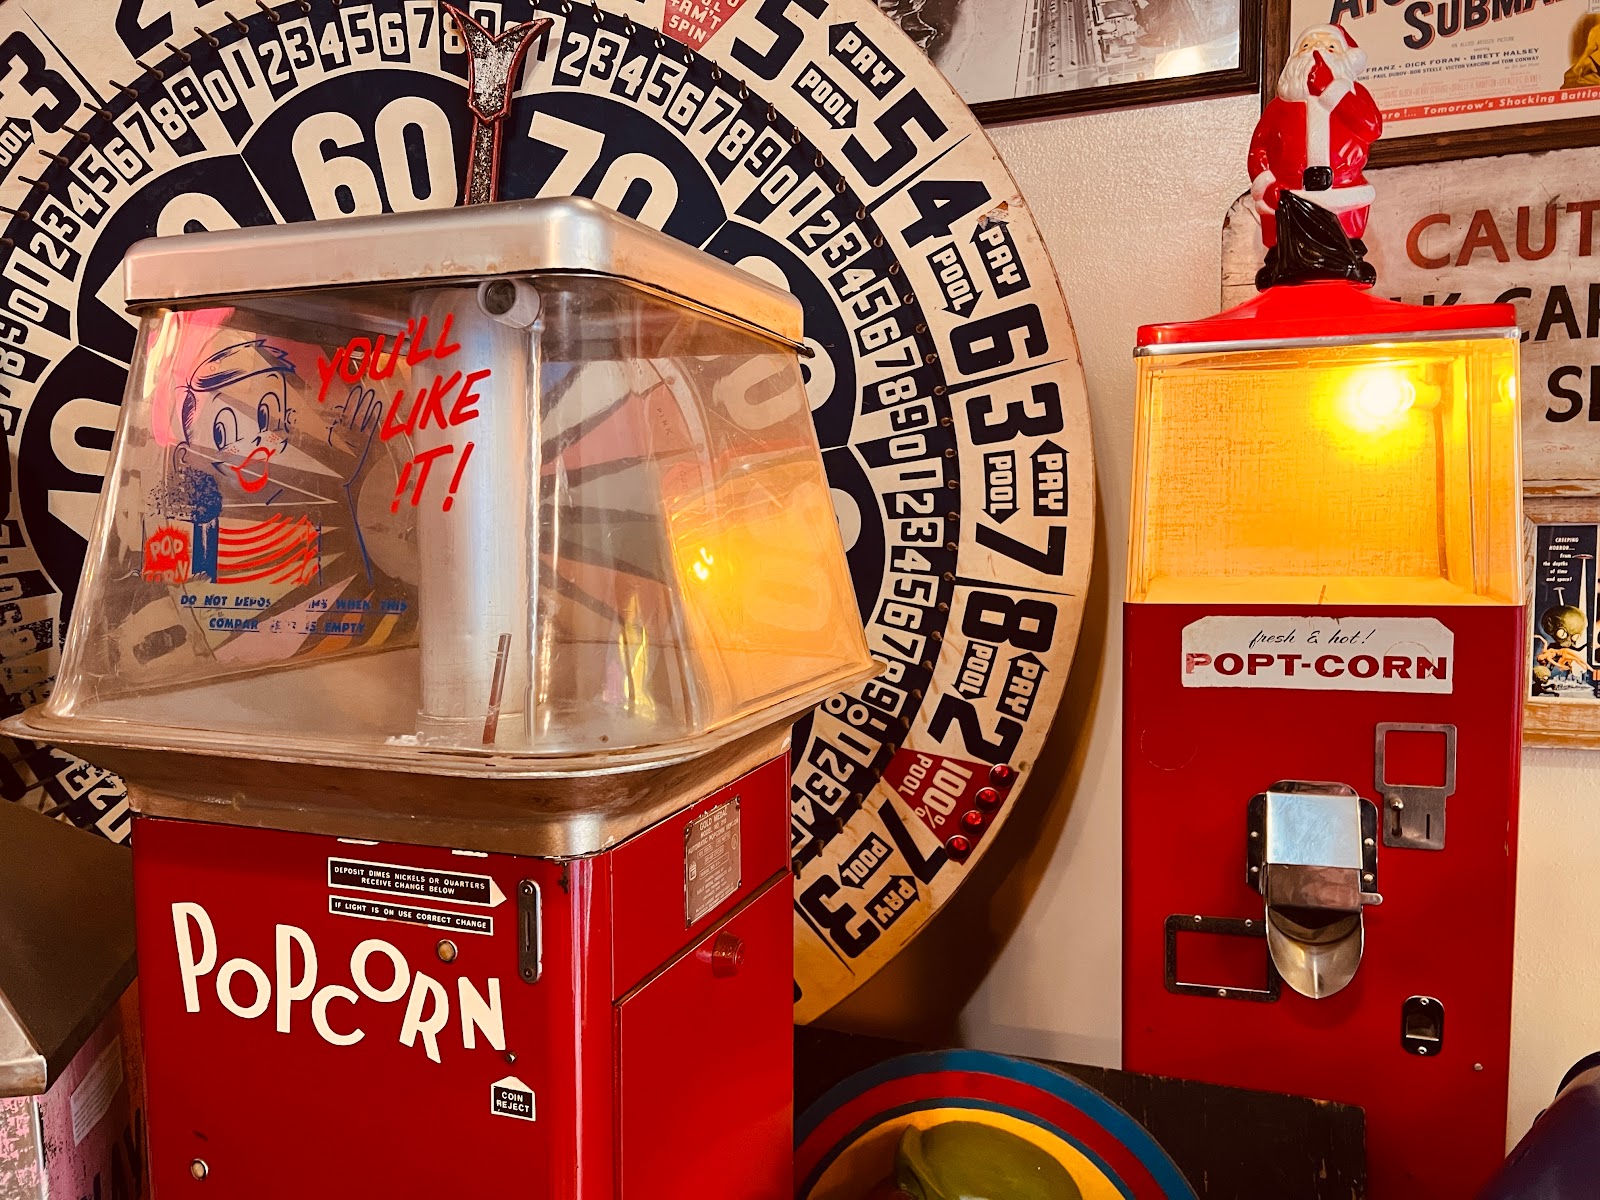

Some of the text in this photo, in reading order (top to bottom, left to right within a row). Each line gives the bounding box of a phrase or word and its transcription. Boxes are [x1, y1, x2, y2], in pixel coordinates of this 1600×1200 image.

[231, 49, 256, 90] 1
[258, 40, 290, 86] 2
[284, 25, 316, 70] 3
[319, 21, 345, 64] 4
[347, 11, 375, 55] 5
[378, 12, 405, 56] 6
[412, 7, 436, 49] 7
[669, 15, 707, 43] SPIN
[835, 30, 895, 87] PAY
[1366, 65, 1396, 73] FRANZ
[1429, 57, 1460, 65] FORAN
[1470, 52, 1500, 60] BRETT
[1503, 48, 1540, 57] HALSEY
[171, 76, 209, 120] 9
[202, 69, 238, 112] 0
[797, 68, 846, 126] POOL
[1424, 100, 1494, 115] Tomorrow's
[1499, 94, 1556, 107] Shocking
[122, 110, 156, 154] 7
[150, 98, 188, 140] 8
[559, 32, 799, 205] 2 3 4 5 6 7 8 9 0
[841, 87, 949, 188] 5
[77, 153, 118, 194] 5
[103, 136, 143, 179] 6
[291, 97, 460, 222] 60
[528, 110, 678, 232] 70
[67, 181, 104, 217] 4
[900, 180, 992, 249] 4
[40, 203, 81, 243] 3
[798, 210, 841, 249] 2
[29, 231, 71, 271] 2
[822, 232, 862, 268] 3
[979, 225, 1022, 285] PAY
[839, 269, 877, 297] 4
[932, 247, 974, 312] POOL
[8, 288, 49, 323] 0
[852, 286, 893, 320] 5
[860, 317, 901, 350] 6
[949, 303, 1049, 376] 6
[317, 313, 462, 403] YOU'LL
[875, 345, 916, 369] 7
[380, 369, 492, 442] LIKE
[877, 375, 918, 400] 8
[657, 408, 672, 436] PINK
[889, 403, 930, 433] 9
[965, 381, 1064, 446] 3
[888, 434, 927, 460] 0
[988, 455, 1013, 514] POOL
[1037, 452, 1063, 510] PAY
[895, 493, 935, 514] 2
[150, 535, 184, 562] POP
[901, 521, 940, 544] 3
[975, 521, 1068, 577] 7
[894, 548, 932, 572] 4
[180, 595, 197, 606] DO
[204, 595, 228, 606] NOT
[335, 599, 371, 610] WHEN
[381, 600, 408, 611] THIS
[894, 578, 933, 604] 5
[325, 622, 366, 633] EMPTY
[884, 607, 923, 630] 6
[961, 590, 1058, 653] 8
[1249, 628, 1376, 649] fresh & hot!
[881, 634, 919, 659] 7
[1185, 653, 1447, 680] POPT-CORN
[958, 643, 994, 695] POOL
[1004, 659, 1040, 715] PAY
[860, 682, 900, 712] 9
[926, 692, 1024, 766] 2
[816, 748, 855, 783] 2
[898, 754, 933, 797] POOL
[805, 772, 842, 810] 3
[915, 759, 973, 829] 100%
[842, 838, 888, 885] POOL
[877, 798, 950, 885] 7
[334, 866, 365, 876] DEPOSIT
[368, 870, 391, 879] DIMES
[394, 873, 426, 883] NICKELS
[443, 878, 485, 890] QUARTERS
[361, 877, 455, 895] RECEIVE CHANGE BELOW
[334, 901, 341, 909] IF
[345, 903, 366, 912] LIGHT
[383, 908, 394, 916] ON
[398, 910, 412, 918] USE
[416, 912, 451, 923] CORRECT
[455, 918, 487, 929] CHANGE
[799, 874, 881, 959] 3
[873, 878, 917, 925] PAY
[171, 901, 506, 1065] POPCORN
[496, 1099, 530, 1114] REJECT
[501, 1091, 524, 1103] COIN
